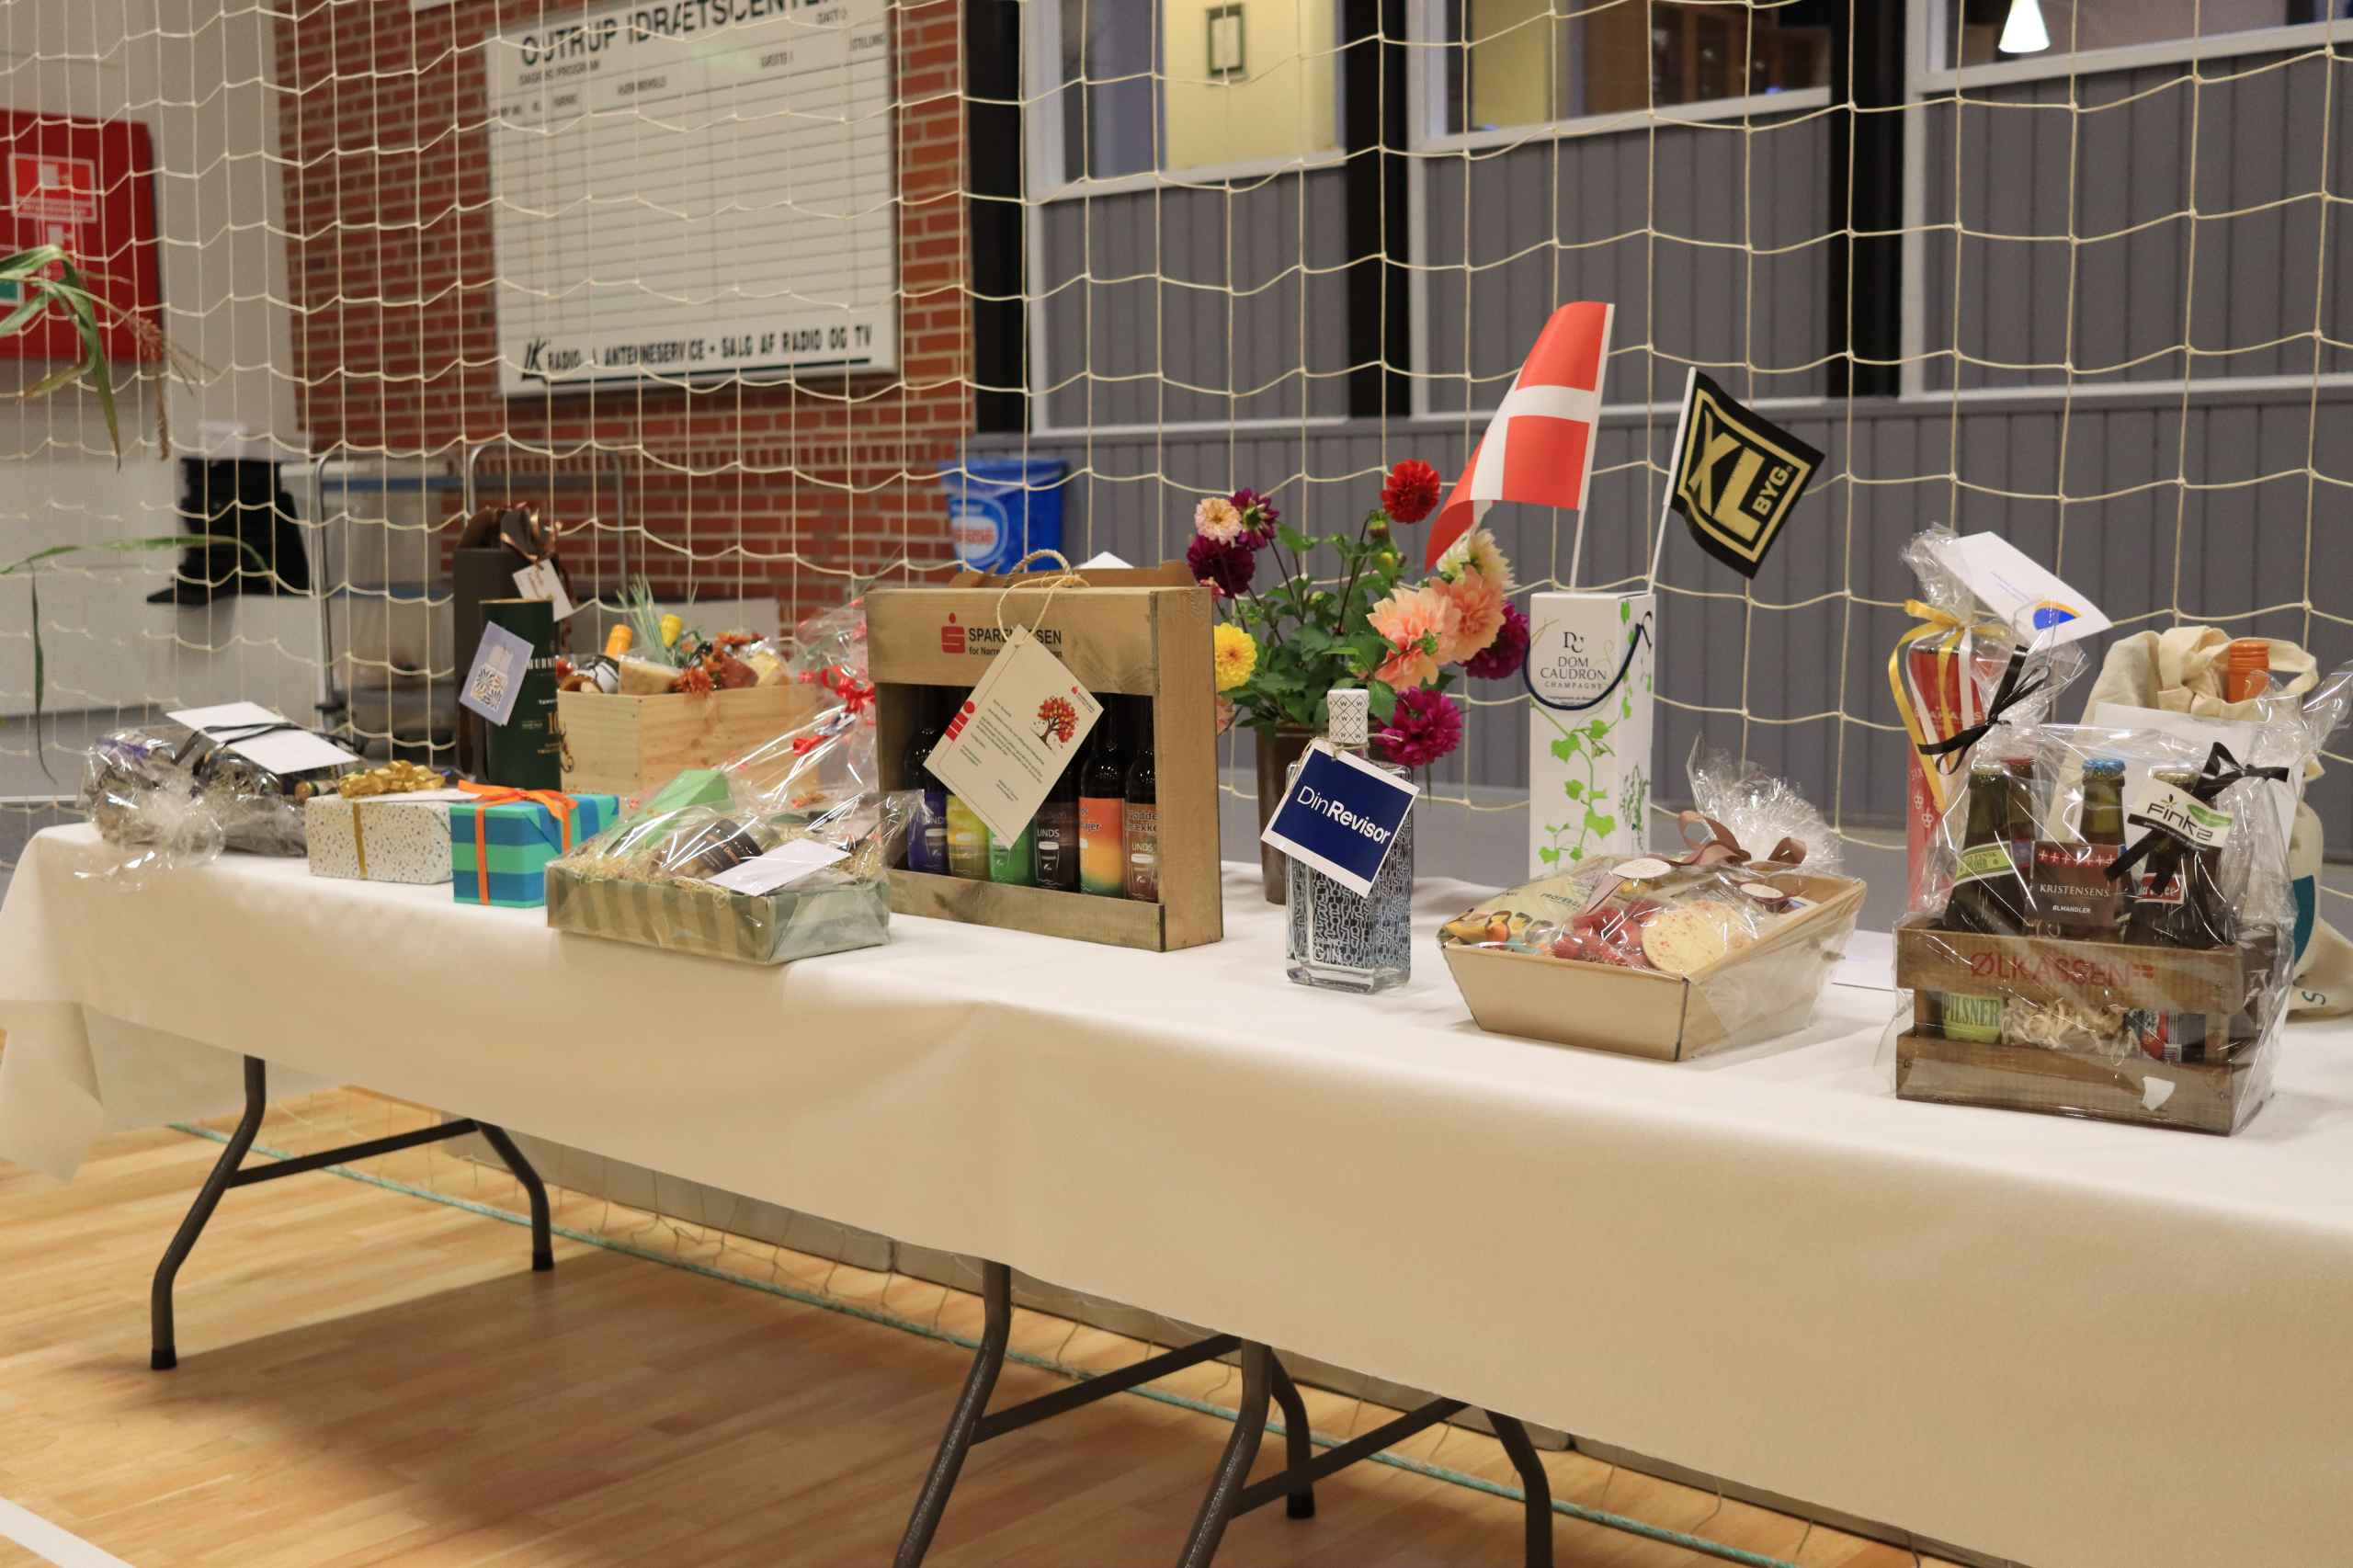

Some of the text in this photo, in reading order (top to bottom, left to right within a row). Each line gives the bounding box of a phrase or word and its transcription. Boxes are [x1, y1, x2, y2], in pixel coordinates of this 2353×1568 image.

[521, 0, 832, 66] OUTRUP IDRÆTSCEN
[760, 333, 775, 356] AF
[783, 328, 823, 353] RADIO
[830, 326, 847, 349] OG
[855, 324, 872, 347] TV
[1752, 465, 1790, 517] BYG
[969, 628, 1063, 645] SPARESEN
[969, 646, 980, 655] for
[1558, 656, 1588, 667] DOM
[1540, 667, 1607, 680] CAUDRON
[1544, 681, 1602, 689] CHAMPAGNE
[1296, 785, 1392, 845] DinRevisor
[2040, 883, 2111, 898] KRISTENSENS
[1970, 951, 2132, 987] ØLKASSEN
[1942, 994, 2000, 1027] PILSNER
